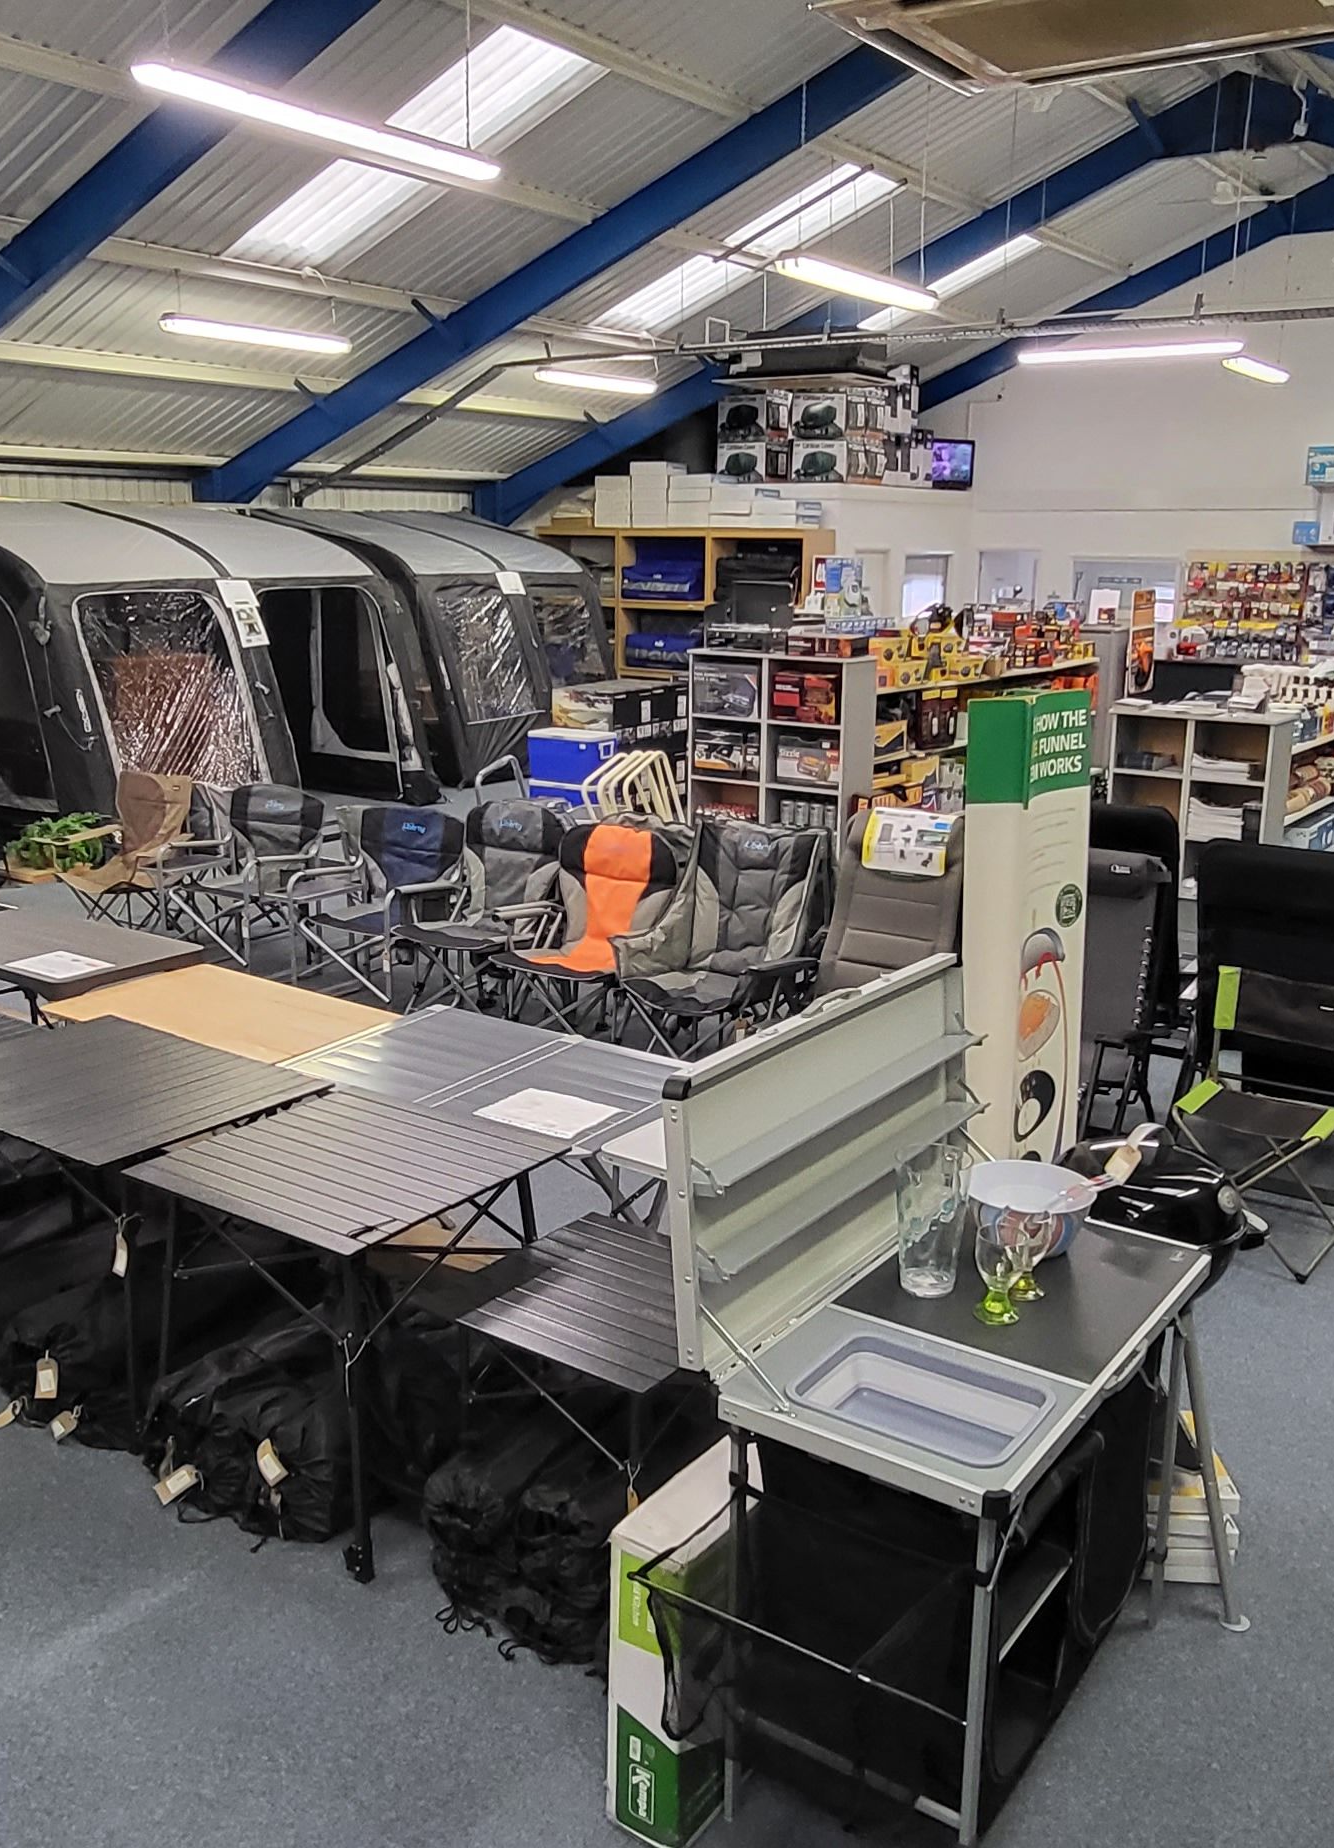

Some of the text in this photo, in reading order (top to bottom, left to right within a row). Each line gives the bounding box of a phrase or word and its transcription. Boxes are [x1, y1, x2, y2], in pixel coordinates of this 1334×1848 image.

[1061, 709, 1087, 728] THE
[1039, 731, 1086, 755] FUNNEL
[1040, 755, 1082, 778] WORKS
[631, 1768, 651, 1818] Kampa
